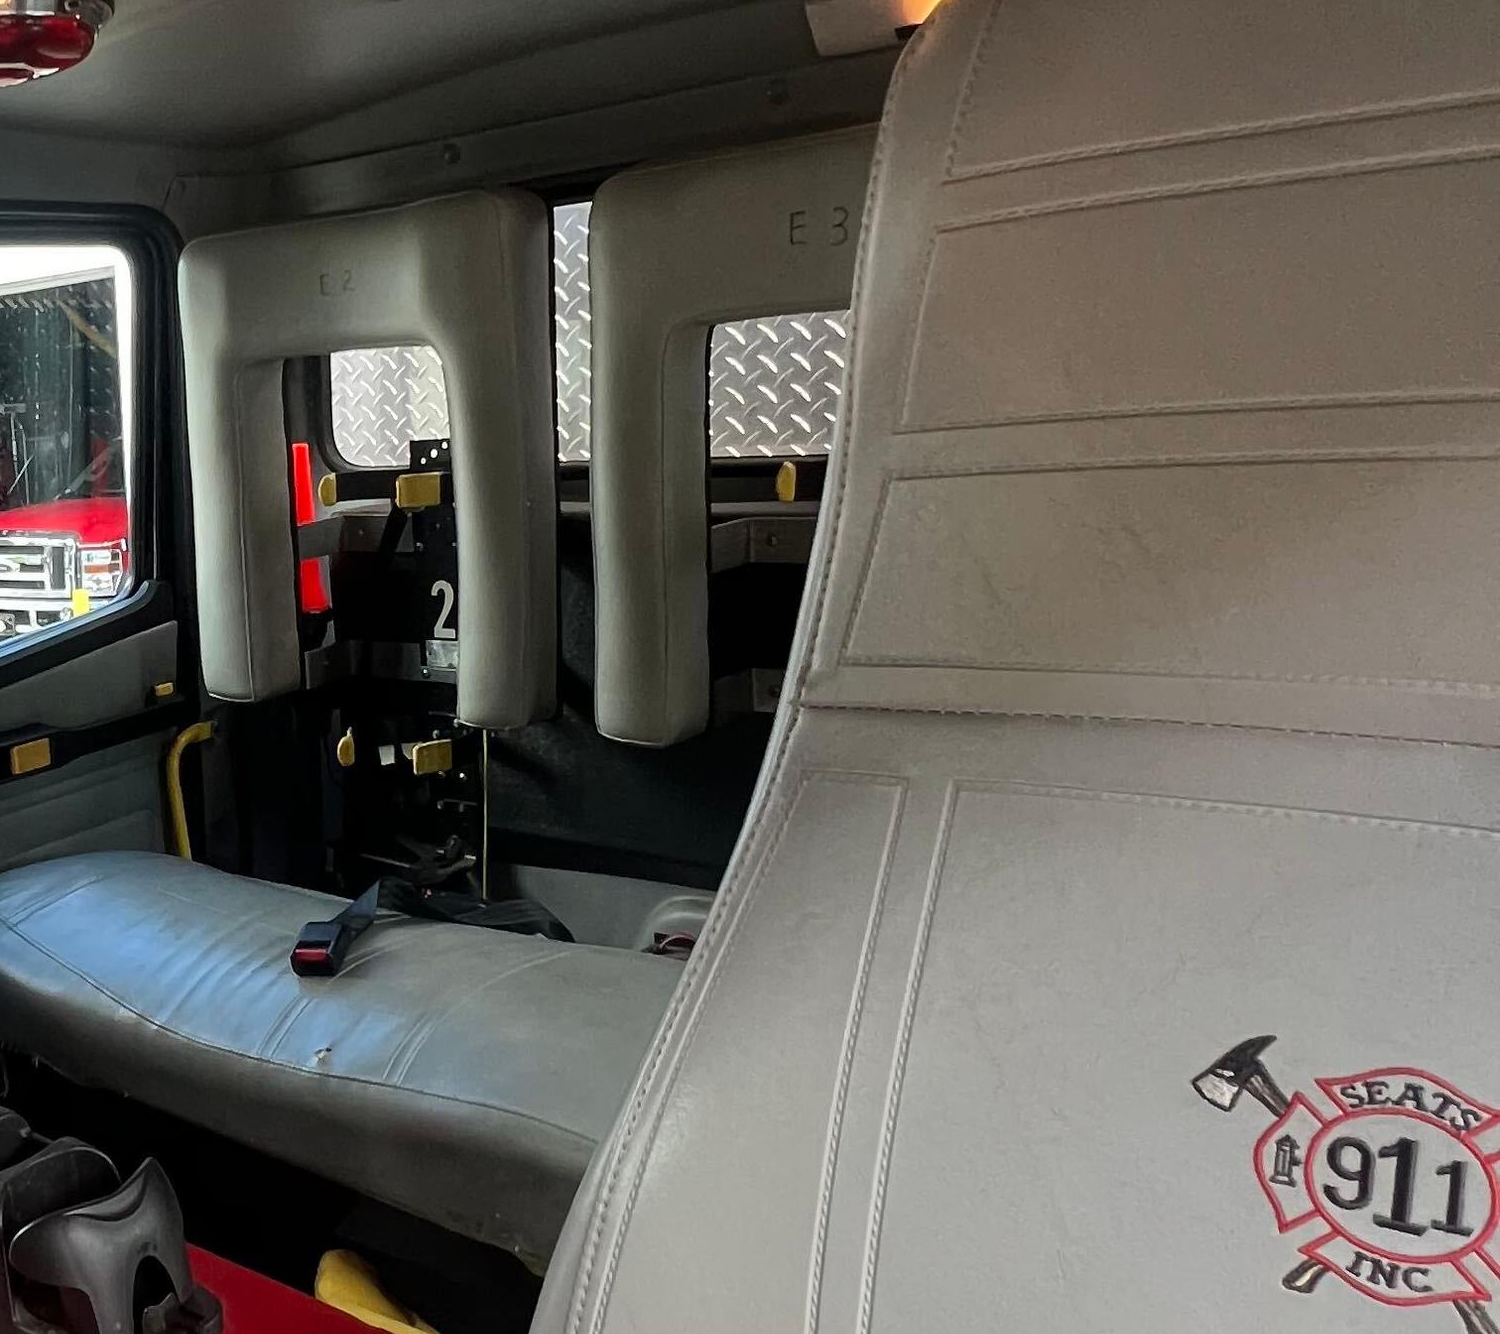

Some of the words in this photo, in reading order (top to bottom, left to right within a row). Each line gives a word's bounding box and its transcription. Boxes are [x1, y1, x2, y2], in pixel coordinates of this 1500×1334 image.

[430, 579, 456, 639] 2
[1339, 1078, 1484, 1132] SEATS
[1321, 1135, 1476, 1238] 911
[1345, 1250, 1434, 1293] INC
